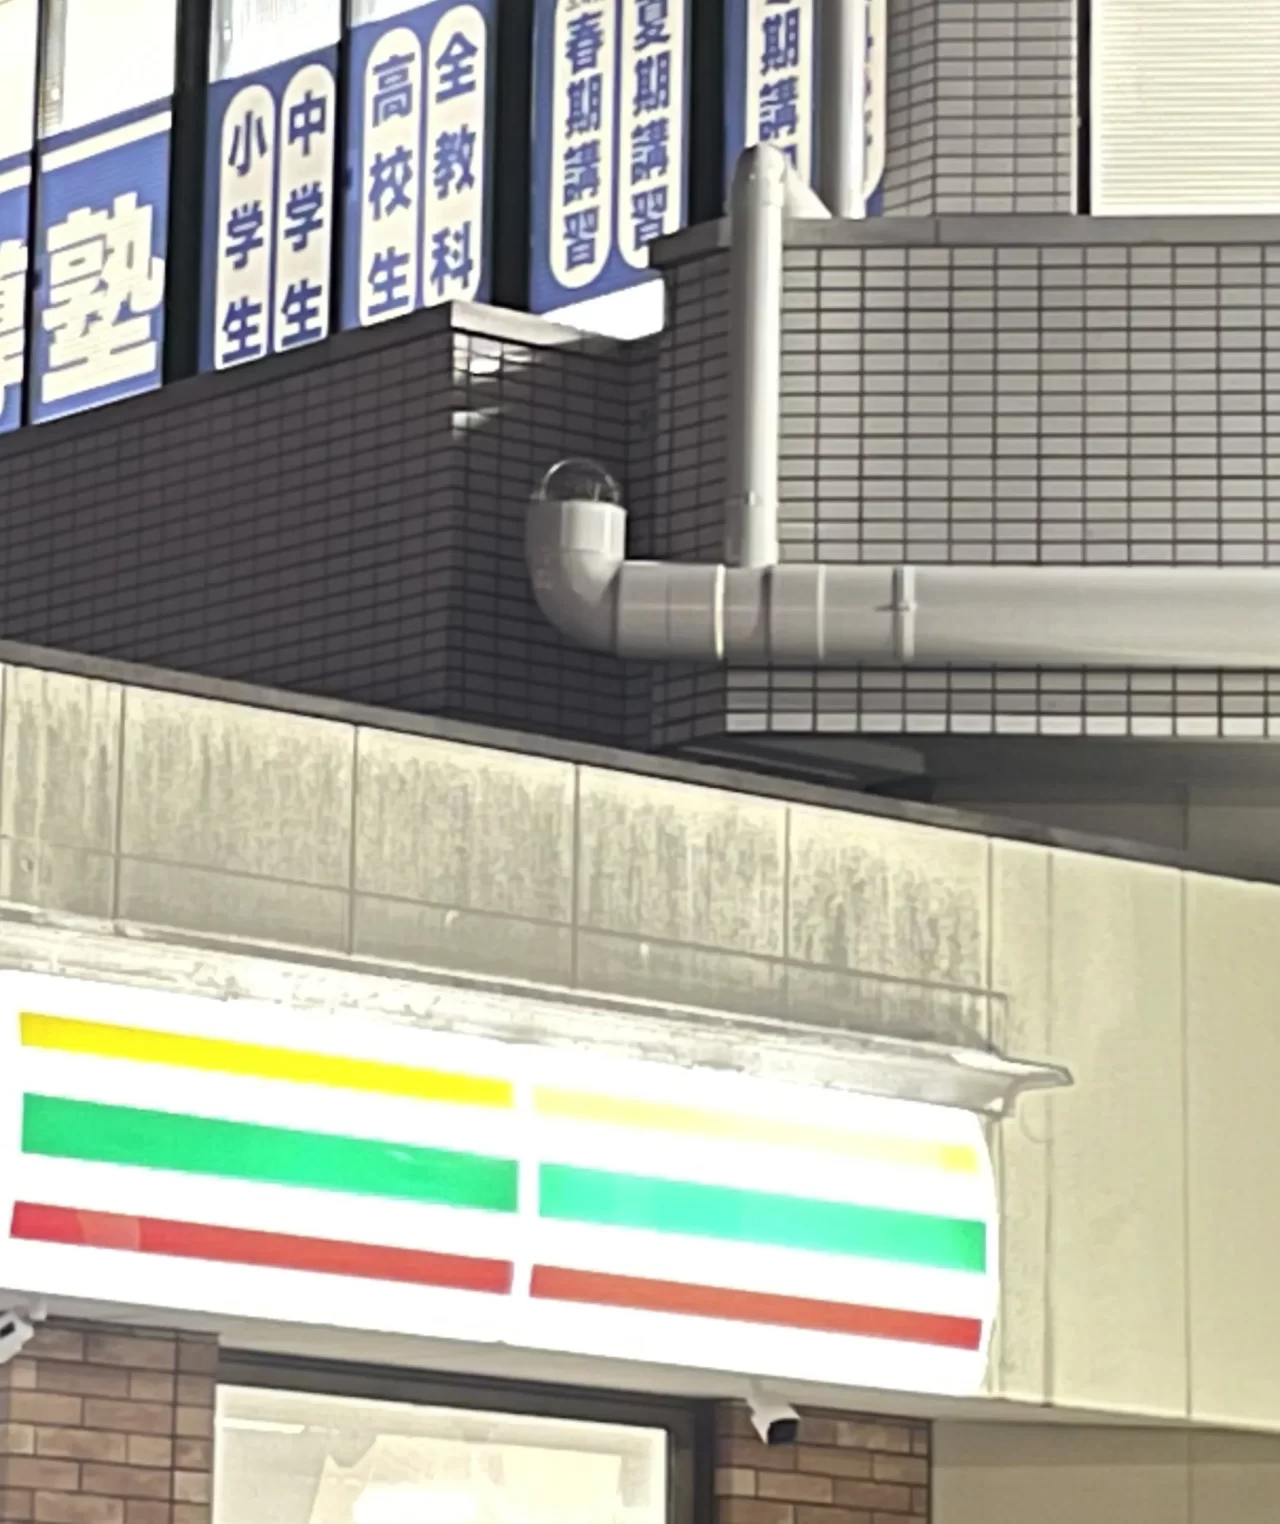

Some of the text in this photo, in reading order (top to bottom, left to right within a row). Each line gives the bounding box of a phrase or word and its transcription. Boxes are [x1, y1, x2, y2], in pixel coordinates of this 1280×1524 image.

[367, 51, 416, 318] 高校生
[429, 30, 479, 297] 全教科
[563, 0, 604, 272] 春期講習
[631, 0, 671, 252] 夏期講習
[759, 0, 801, 170] 期講
[221, 110, 267, 364] 小学生
[280, 89, 327, 348] 中学生
